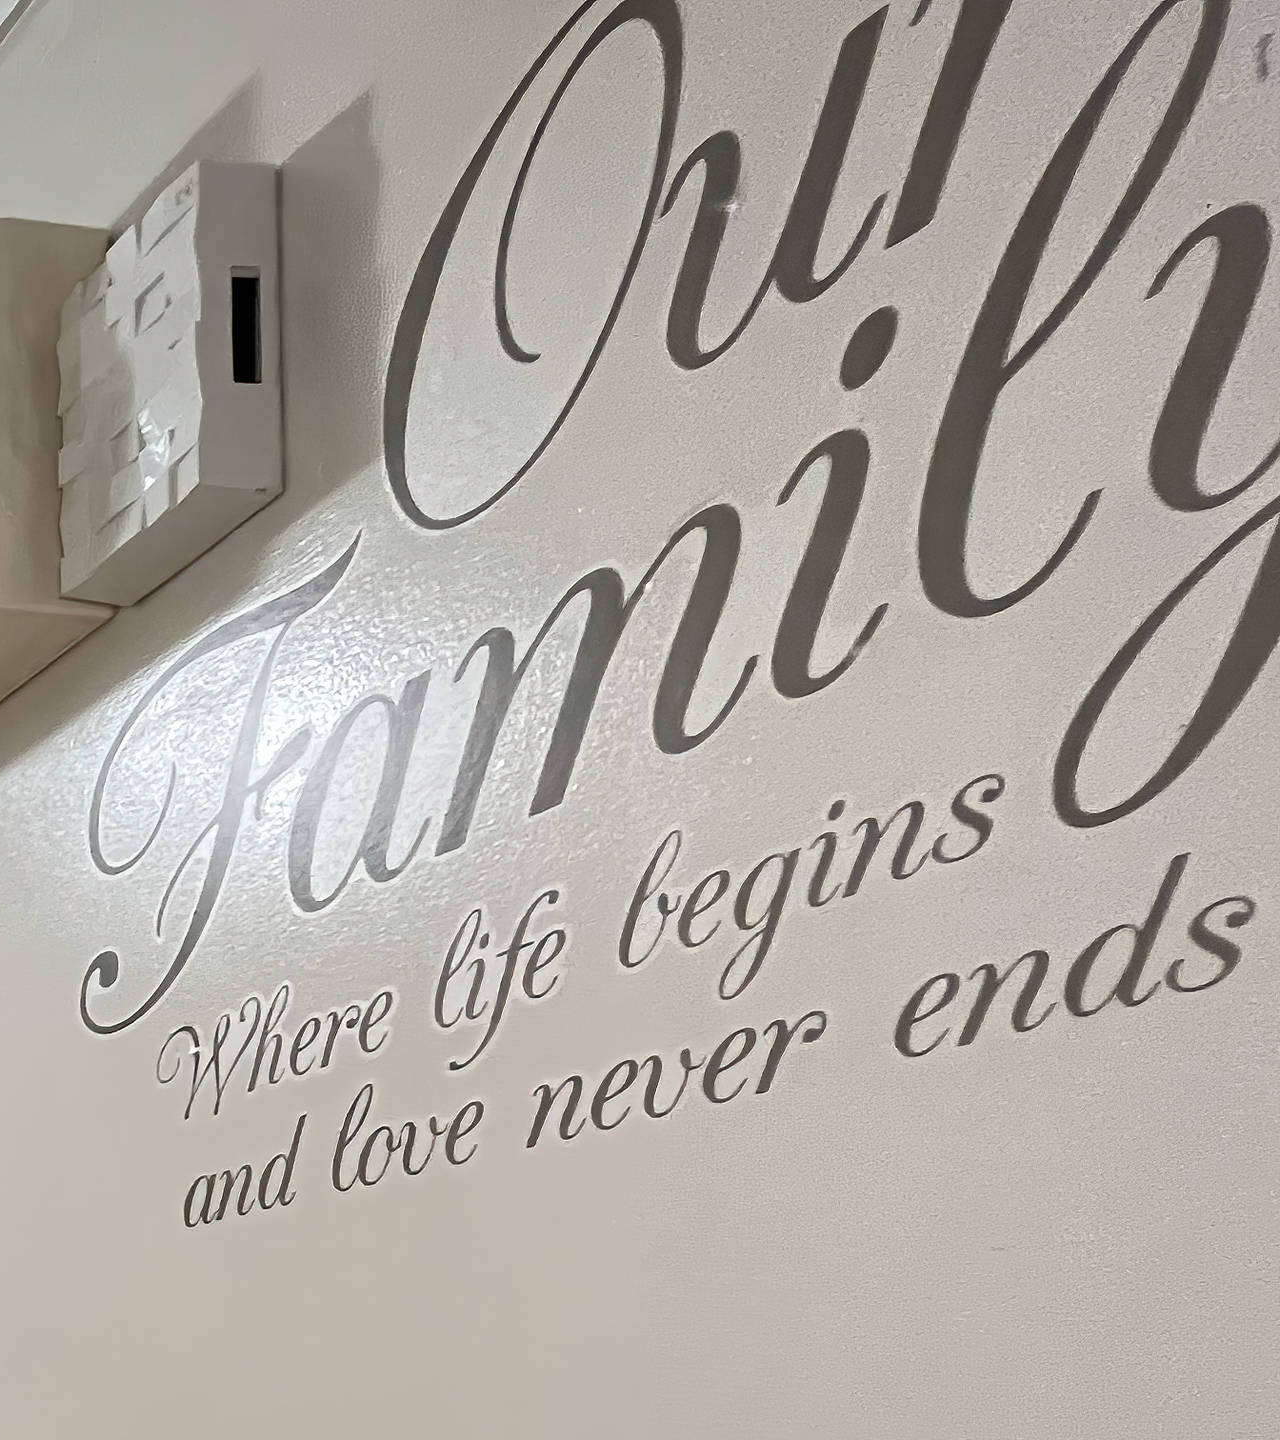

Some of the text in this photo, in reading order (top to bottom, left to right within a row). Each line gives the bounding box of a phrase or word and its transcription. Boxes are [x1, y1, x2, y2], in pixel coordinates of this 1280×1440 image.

[156, 773, 1006, 1120] Where life begins
[183, 852, 1257, 1229] and love never ends
